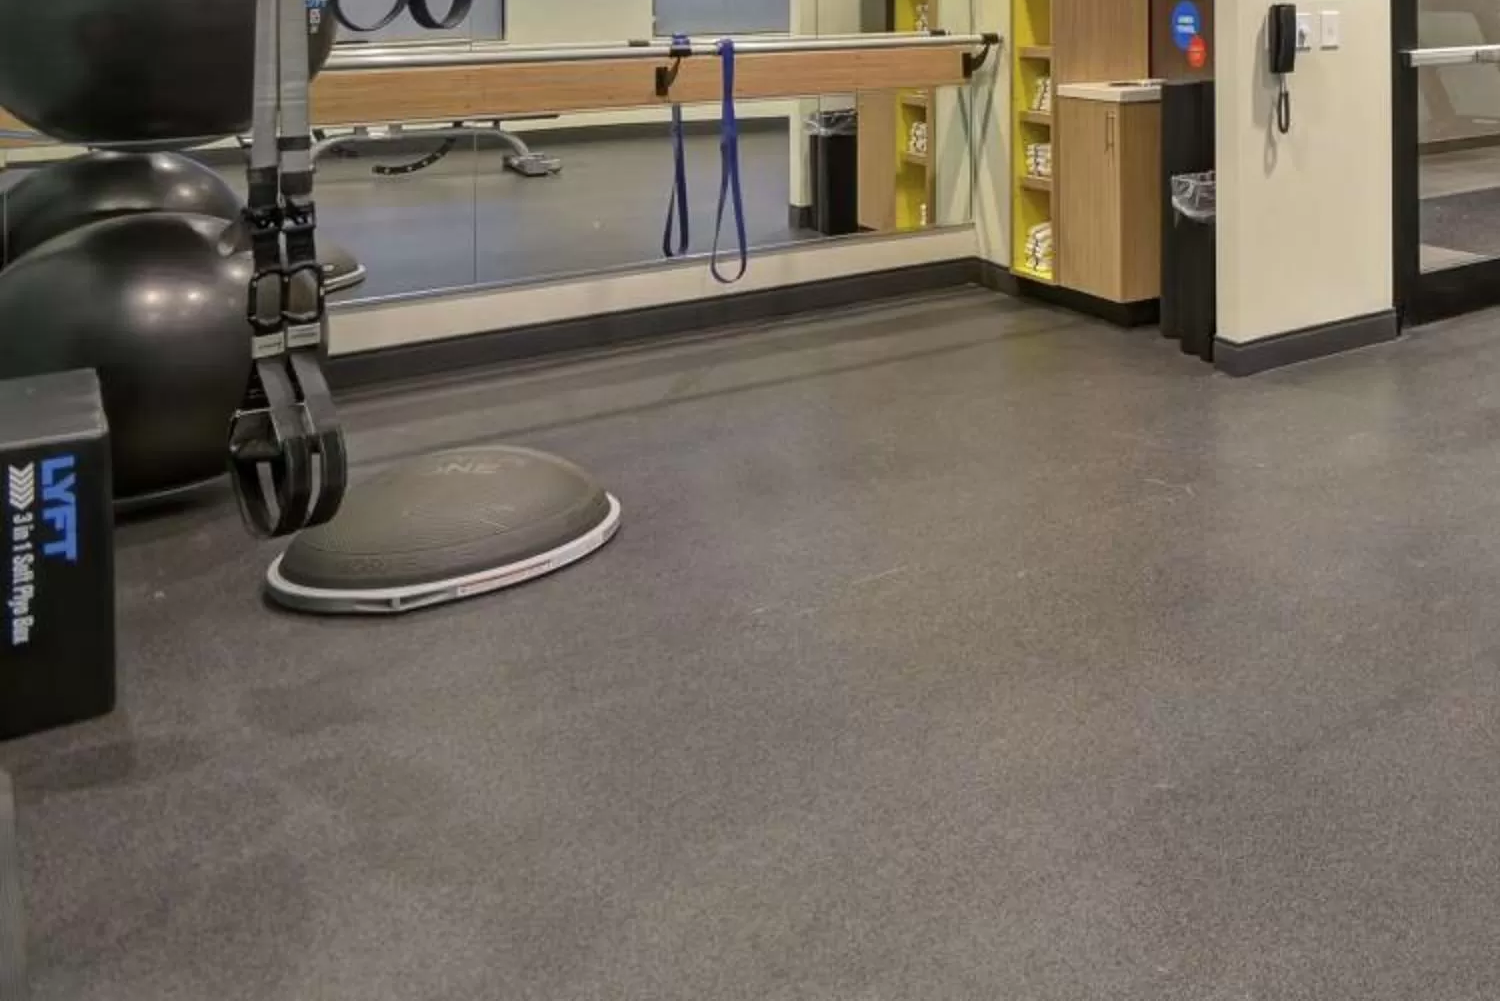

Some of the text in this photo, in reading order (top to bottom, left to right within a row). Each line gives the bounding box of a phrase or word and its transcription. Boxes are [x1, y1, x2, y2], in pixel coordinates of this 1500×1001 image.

[41, 455, 77, 561] LYFT
[12, 511, 33, 524] 3
[12, 524, 35, 541] in
[13, 542, 33, 552] 1
